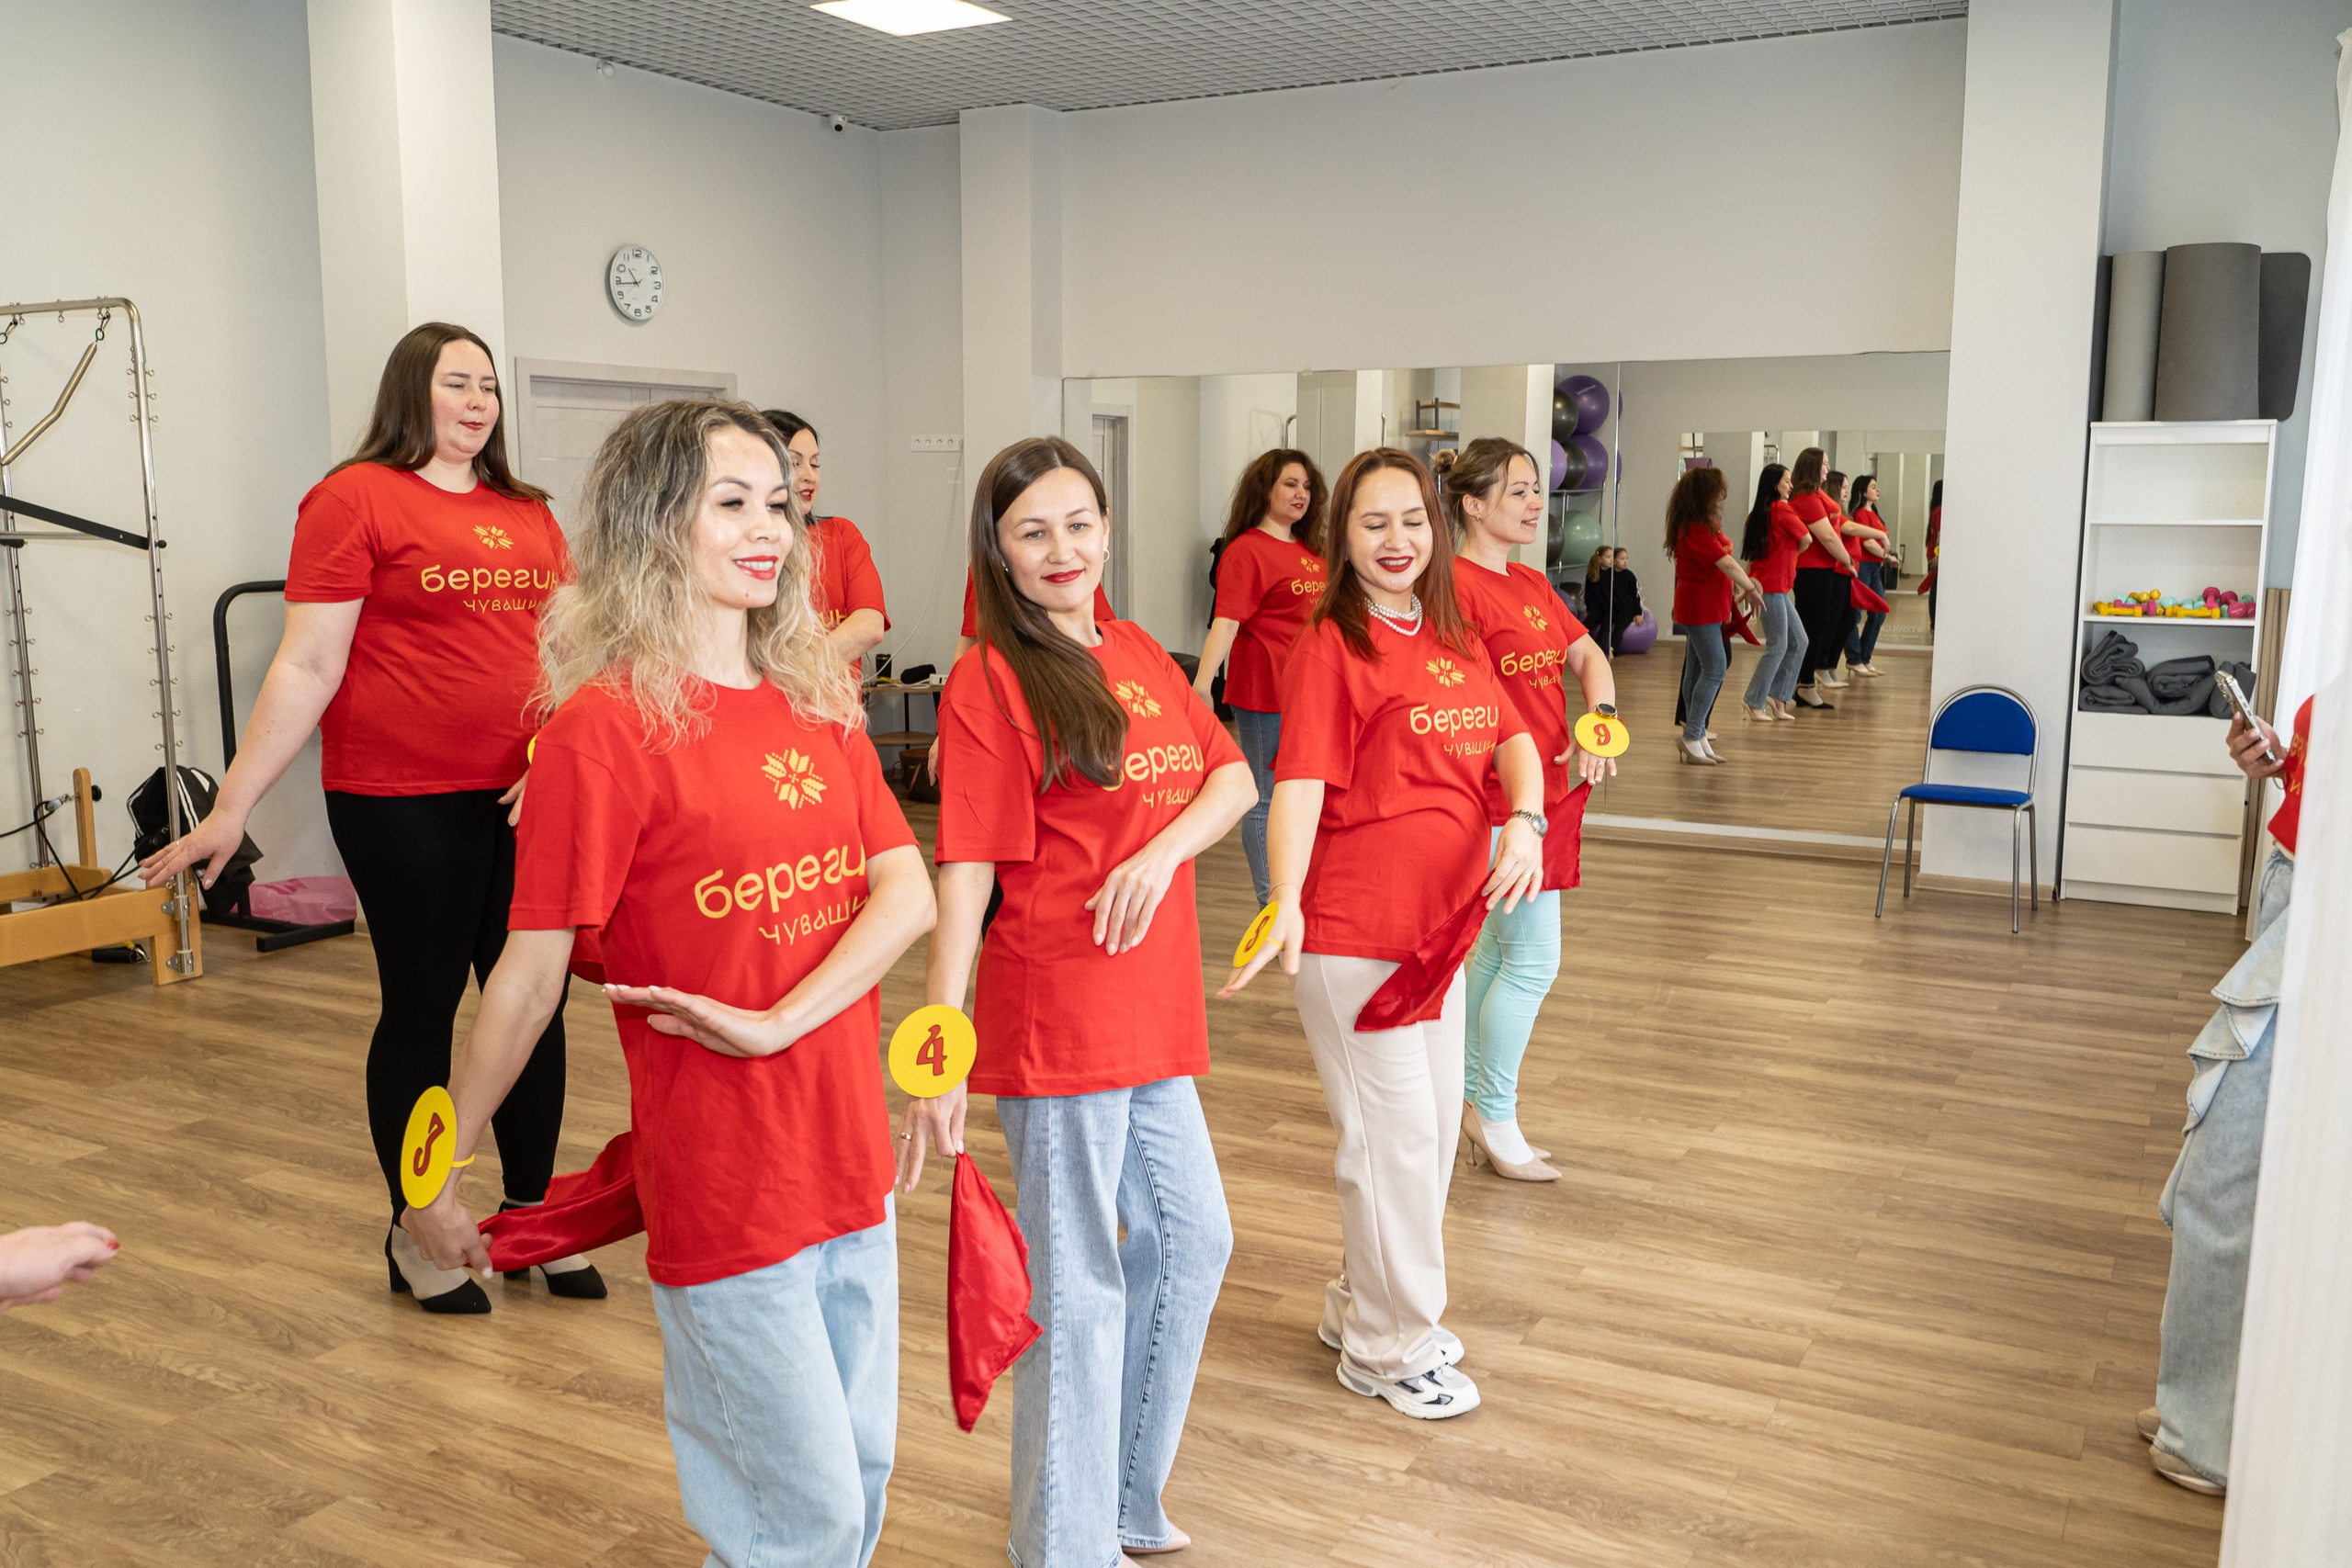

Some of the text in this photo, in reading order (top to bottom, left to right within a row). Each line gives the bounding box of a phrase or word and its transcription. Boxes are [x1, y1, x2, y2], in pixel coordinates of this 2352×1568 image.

[632, 248, 642, 258] 12
[650, 265, 659, 275] 2
[653, 281, 662, 290] 3
[651, 295, 659, 303] 4
[624, 302, 631, 311] 7
[645, 305, 652, 313] 5
[634, 308, 642, 318] 6
[1409, 704, 1498, 738] береги
[1593, 723, 1611, 746] 9
[695, 843, 865, 919] береги
[916, 1023, 947, 1077] 4
